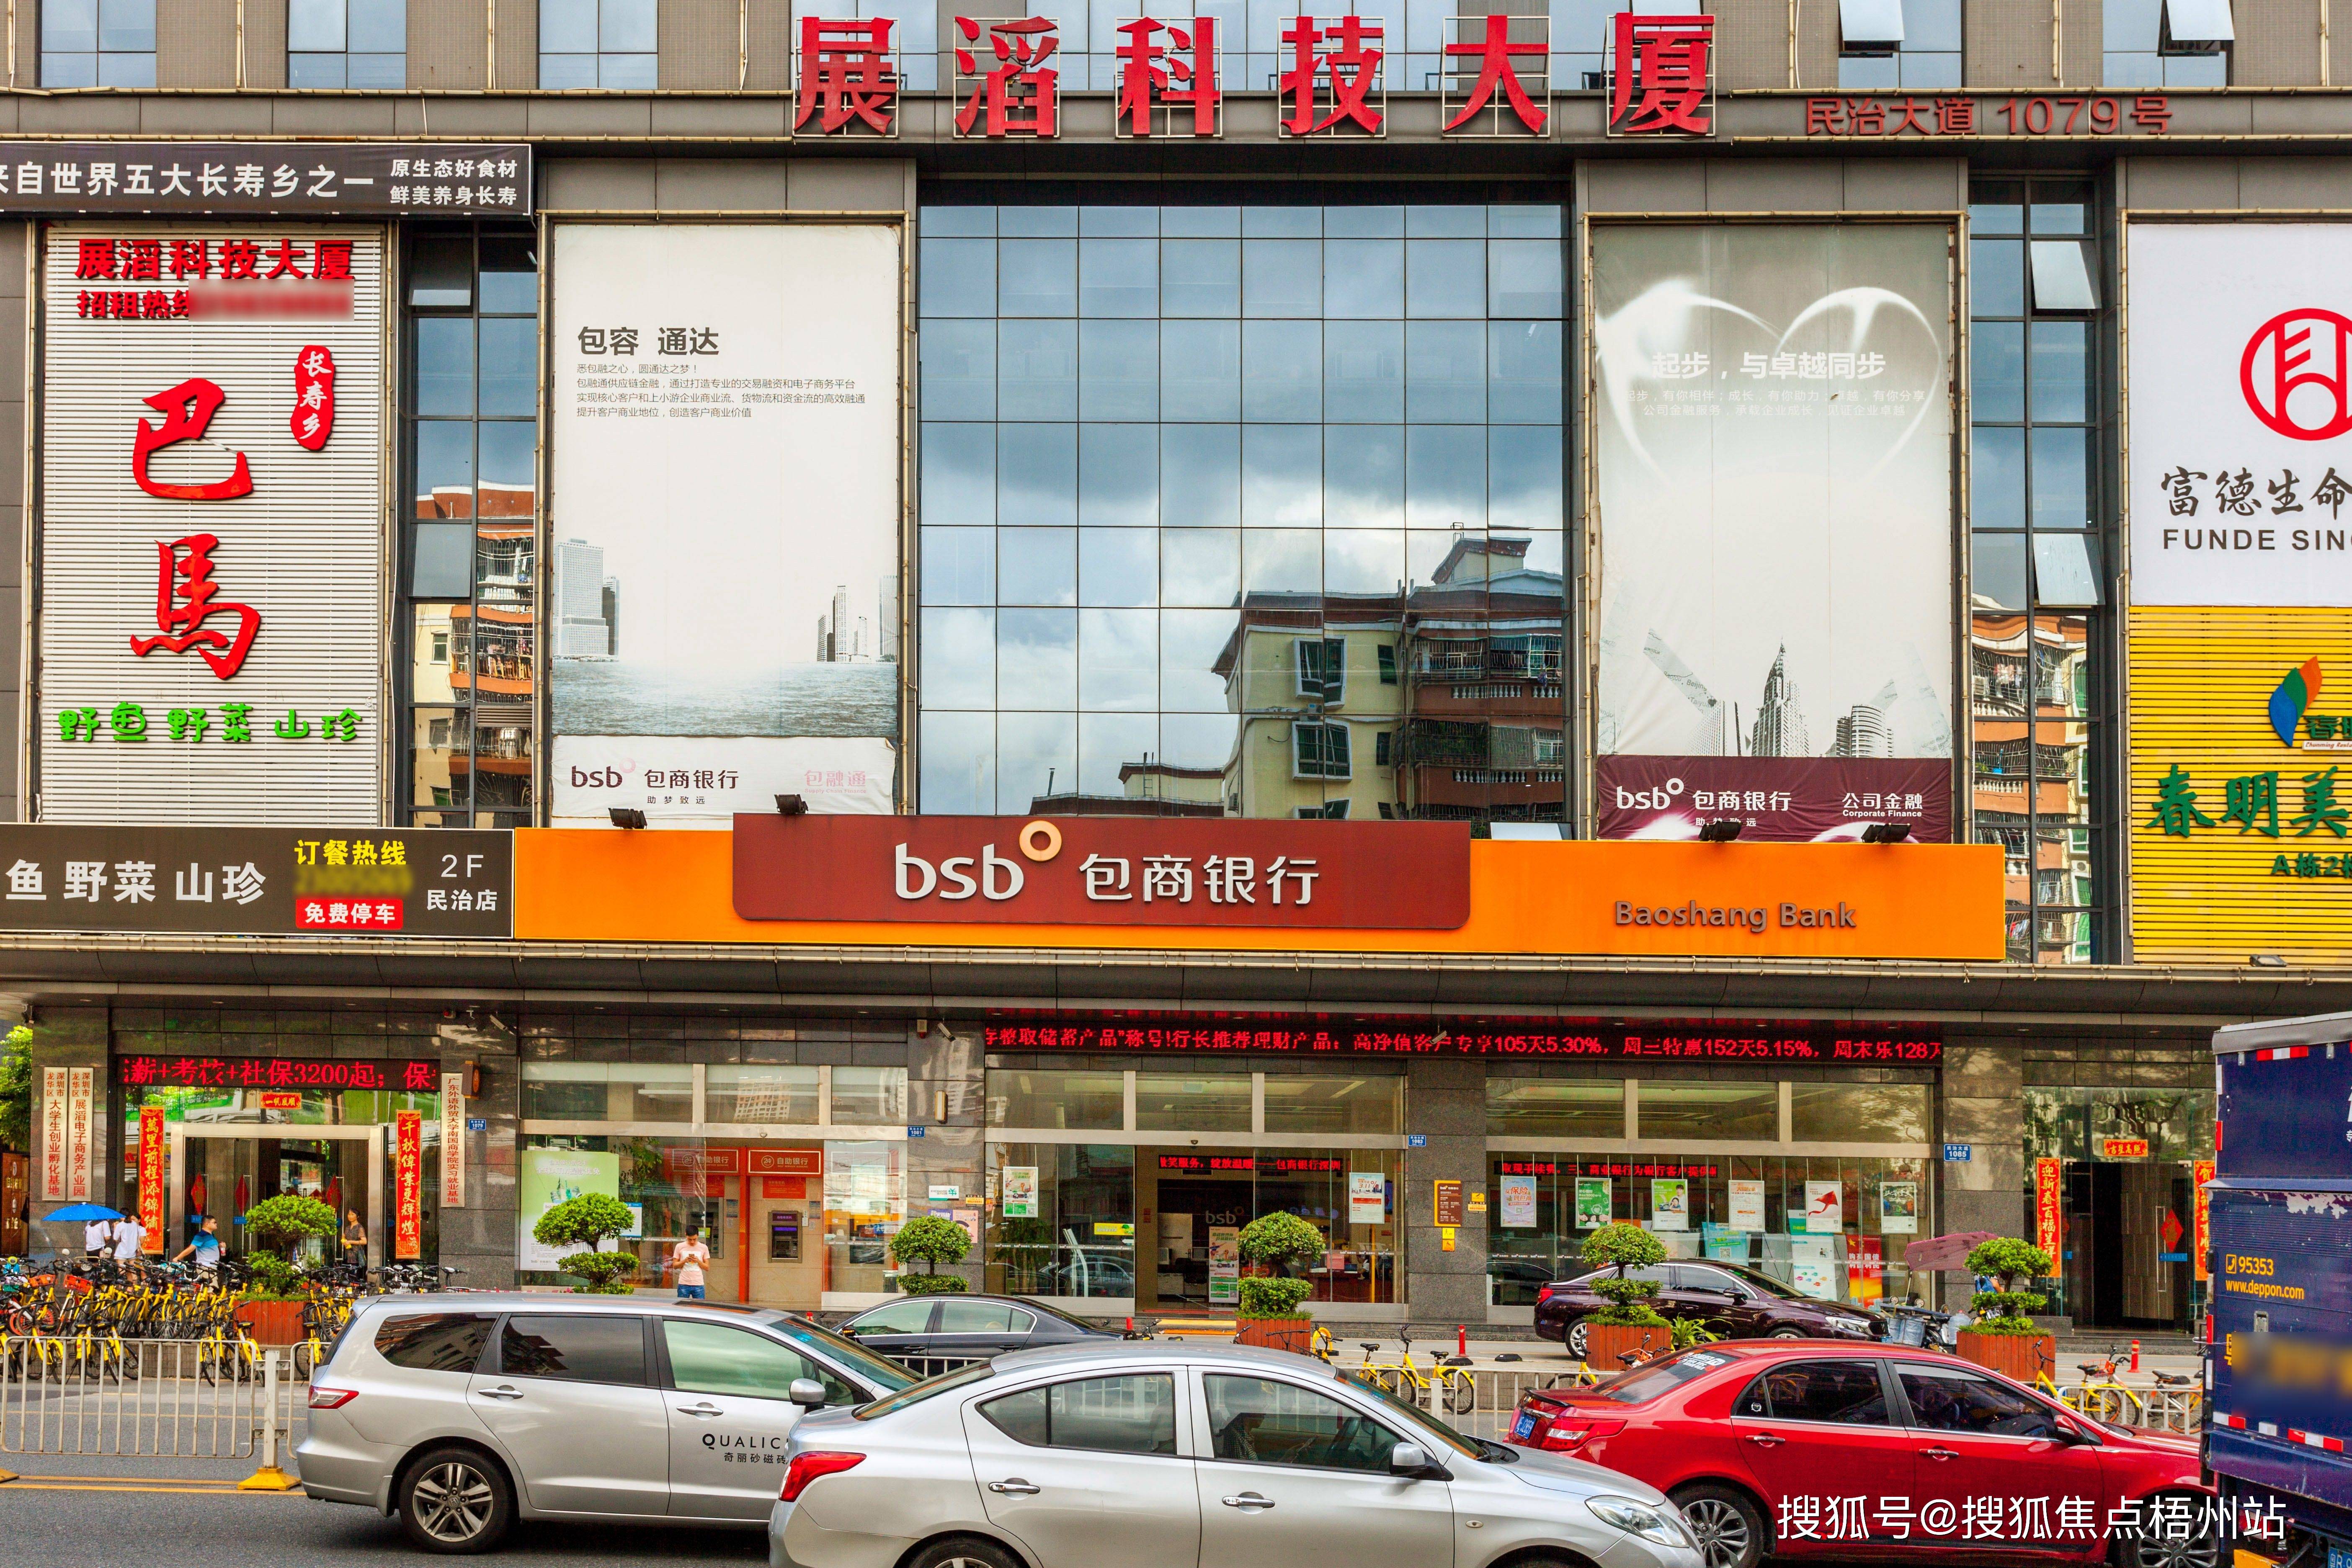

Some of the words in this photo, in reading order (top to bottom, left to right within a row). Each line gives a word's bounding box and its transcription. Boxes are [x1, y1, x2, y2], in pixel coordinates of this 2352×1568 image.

[793, 13, 1714, 137] 展滔科技大厦
[1806, 97, 1976, 135] 民治大道
[0, 161, 374, 198] 自世界五大长寿乡之一
[390, 159, 518, 178] 原生态好食材
[390, 186, 518, 206] 鲜美养身长寿
[75, 239, 355, 280] 展滔科技大厦
[578, 327, 639, 356] 包容
[657, 327, 719, 355] 通达
[299, 351, 332, 442] 长寿乡
[2161, 466, 2352, 520] 富德生命
[2163, 529, 2275, 549] FUNDE
[2292, 529, 2352, 550] SIN
[571, 766, 623, 788] bsb
[644, 769, 739, 789] 包商银行
[805, 770, 867, 787] 包融通
[1617, 786, 1669, 809] bsb
[1692, 790, 1792, 811] 包商银行
[1842, 793, 1922, 810] 公司金融
[2144, 764, 2349, 838] 春明美
[295, 840, 407, 865] 订餐热线
[441, 854, 484, 877] 2F
[895, 843, 1024, 900] bsb
[1079, 853, 1319, 905] 包商银行
[427, 890, 498, 911] 民治店
[305, 903, 396, 925] 免费停车
[1614, 899, 1767, 933] Baoshang
[1779, 902, 1857, 930] Bank
[82, 1072, 90, 1097] 深圳市
[48, 1099, 61, 1196] 大学生创业孵化基地
[73, 1099, 87, 1197] 展滔电子商务产业园
[447, 1078, 459, 1203] 广东外语外贸大学南国商学院实习就业基地
[1206, 1210, 1236, 1224] bsb
[2239, 1256, 2274, 1276] 95353
[2225, 1279, 2305, 1300] www.deppon.com
[702, 1433, 789, 1449] QUALIC
